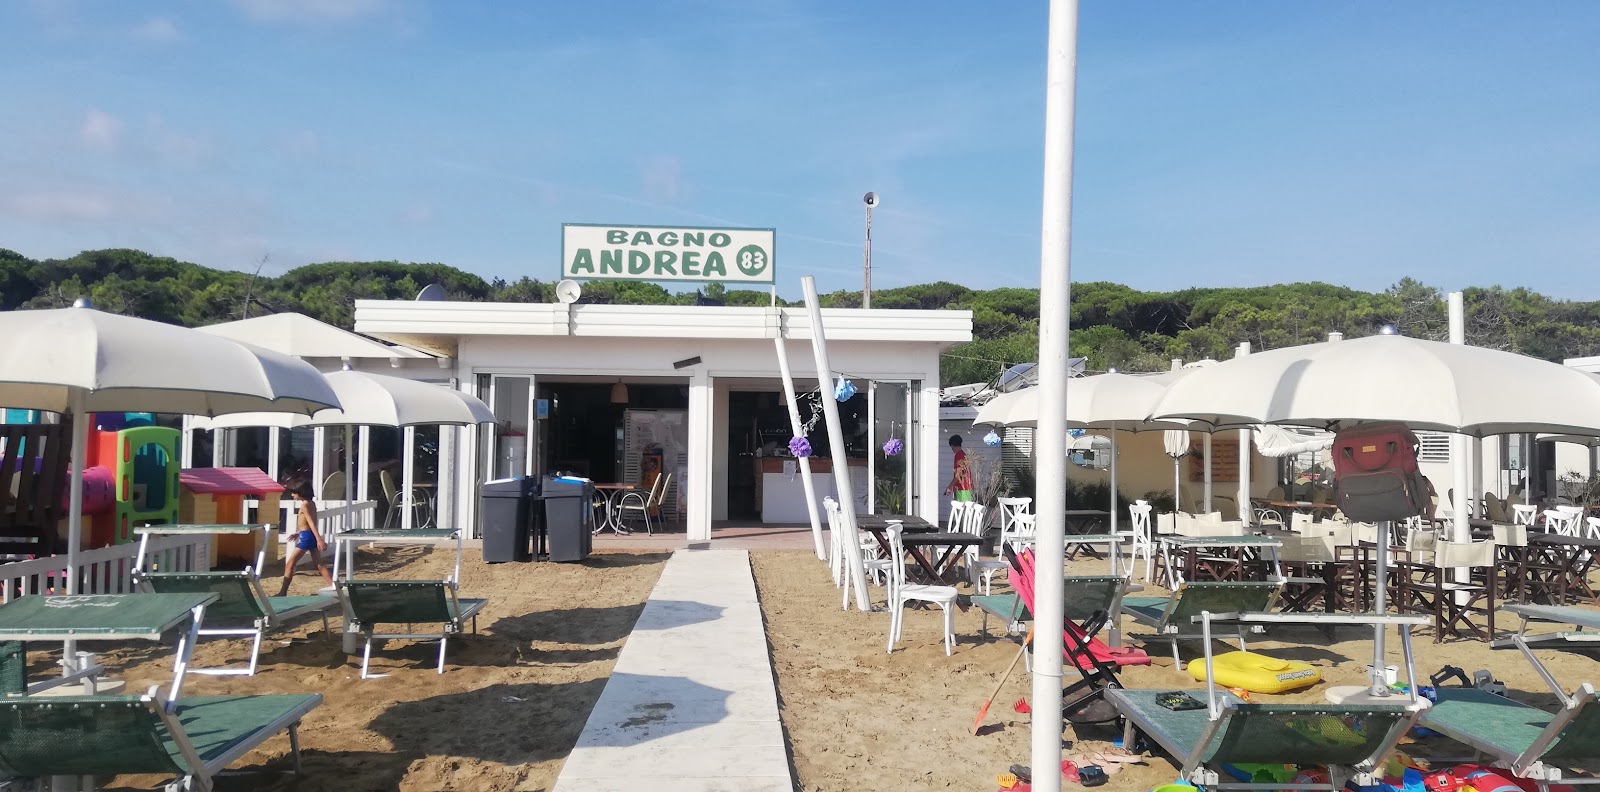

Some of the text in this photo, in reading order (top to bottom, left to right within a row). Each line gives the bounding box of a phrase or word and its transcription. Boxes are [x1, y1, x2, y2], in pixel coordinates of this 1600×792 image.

[606, 229, 732, 248] BAGNO
[570, 248, 765, 277] ANDREA 83
